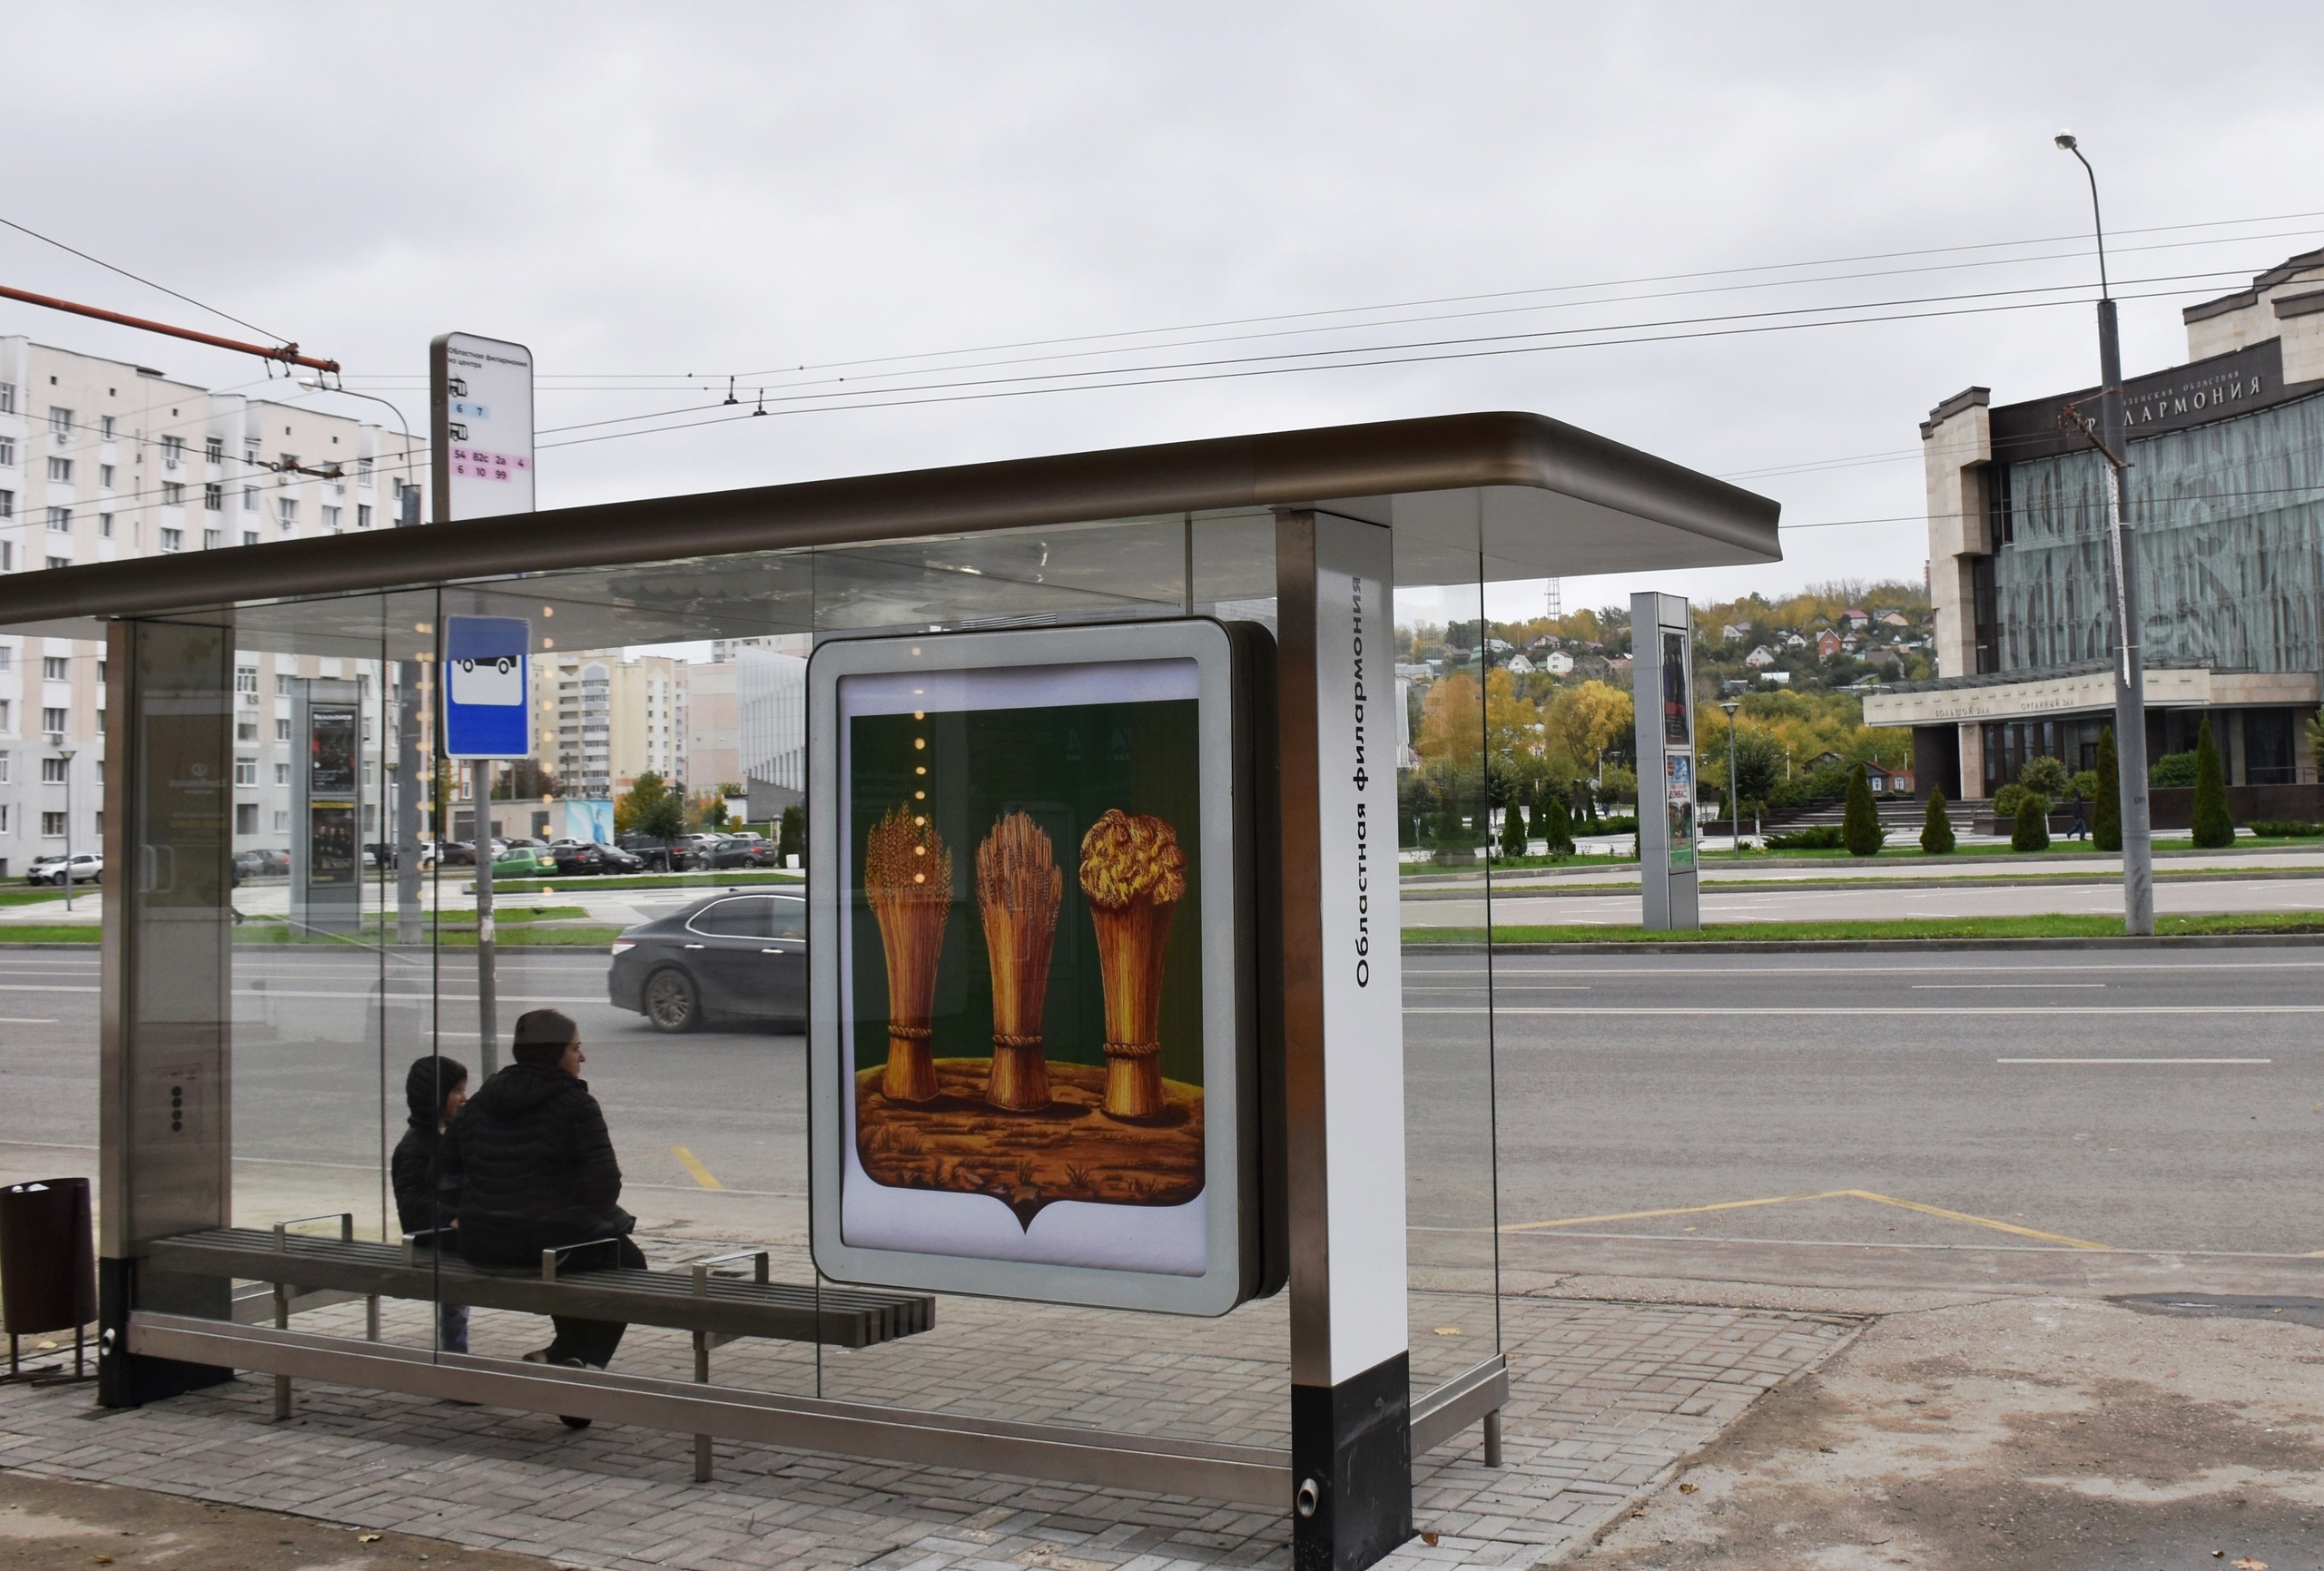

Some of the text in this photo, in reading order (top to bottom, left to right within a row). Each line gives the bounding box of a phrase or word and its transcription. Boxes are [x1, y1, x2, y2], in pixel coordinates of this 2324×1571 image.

[2183, 370, 2239, 392] ОБЛАСТНАЯ
[456, 404, 483, 416] 6 7
[454, 449, 467, 459] 54
[517, 458, 525, 467] 4
[458, 465, 507, 480] 6 10 99
[1935, 706, 1974, 717] БОЛЬШОЙ
[2021, 698, 2060, 711] ОРГАННЫЙ
[1352, 576, 1370, 988] Областная филармония
